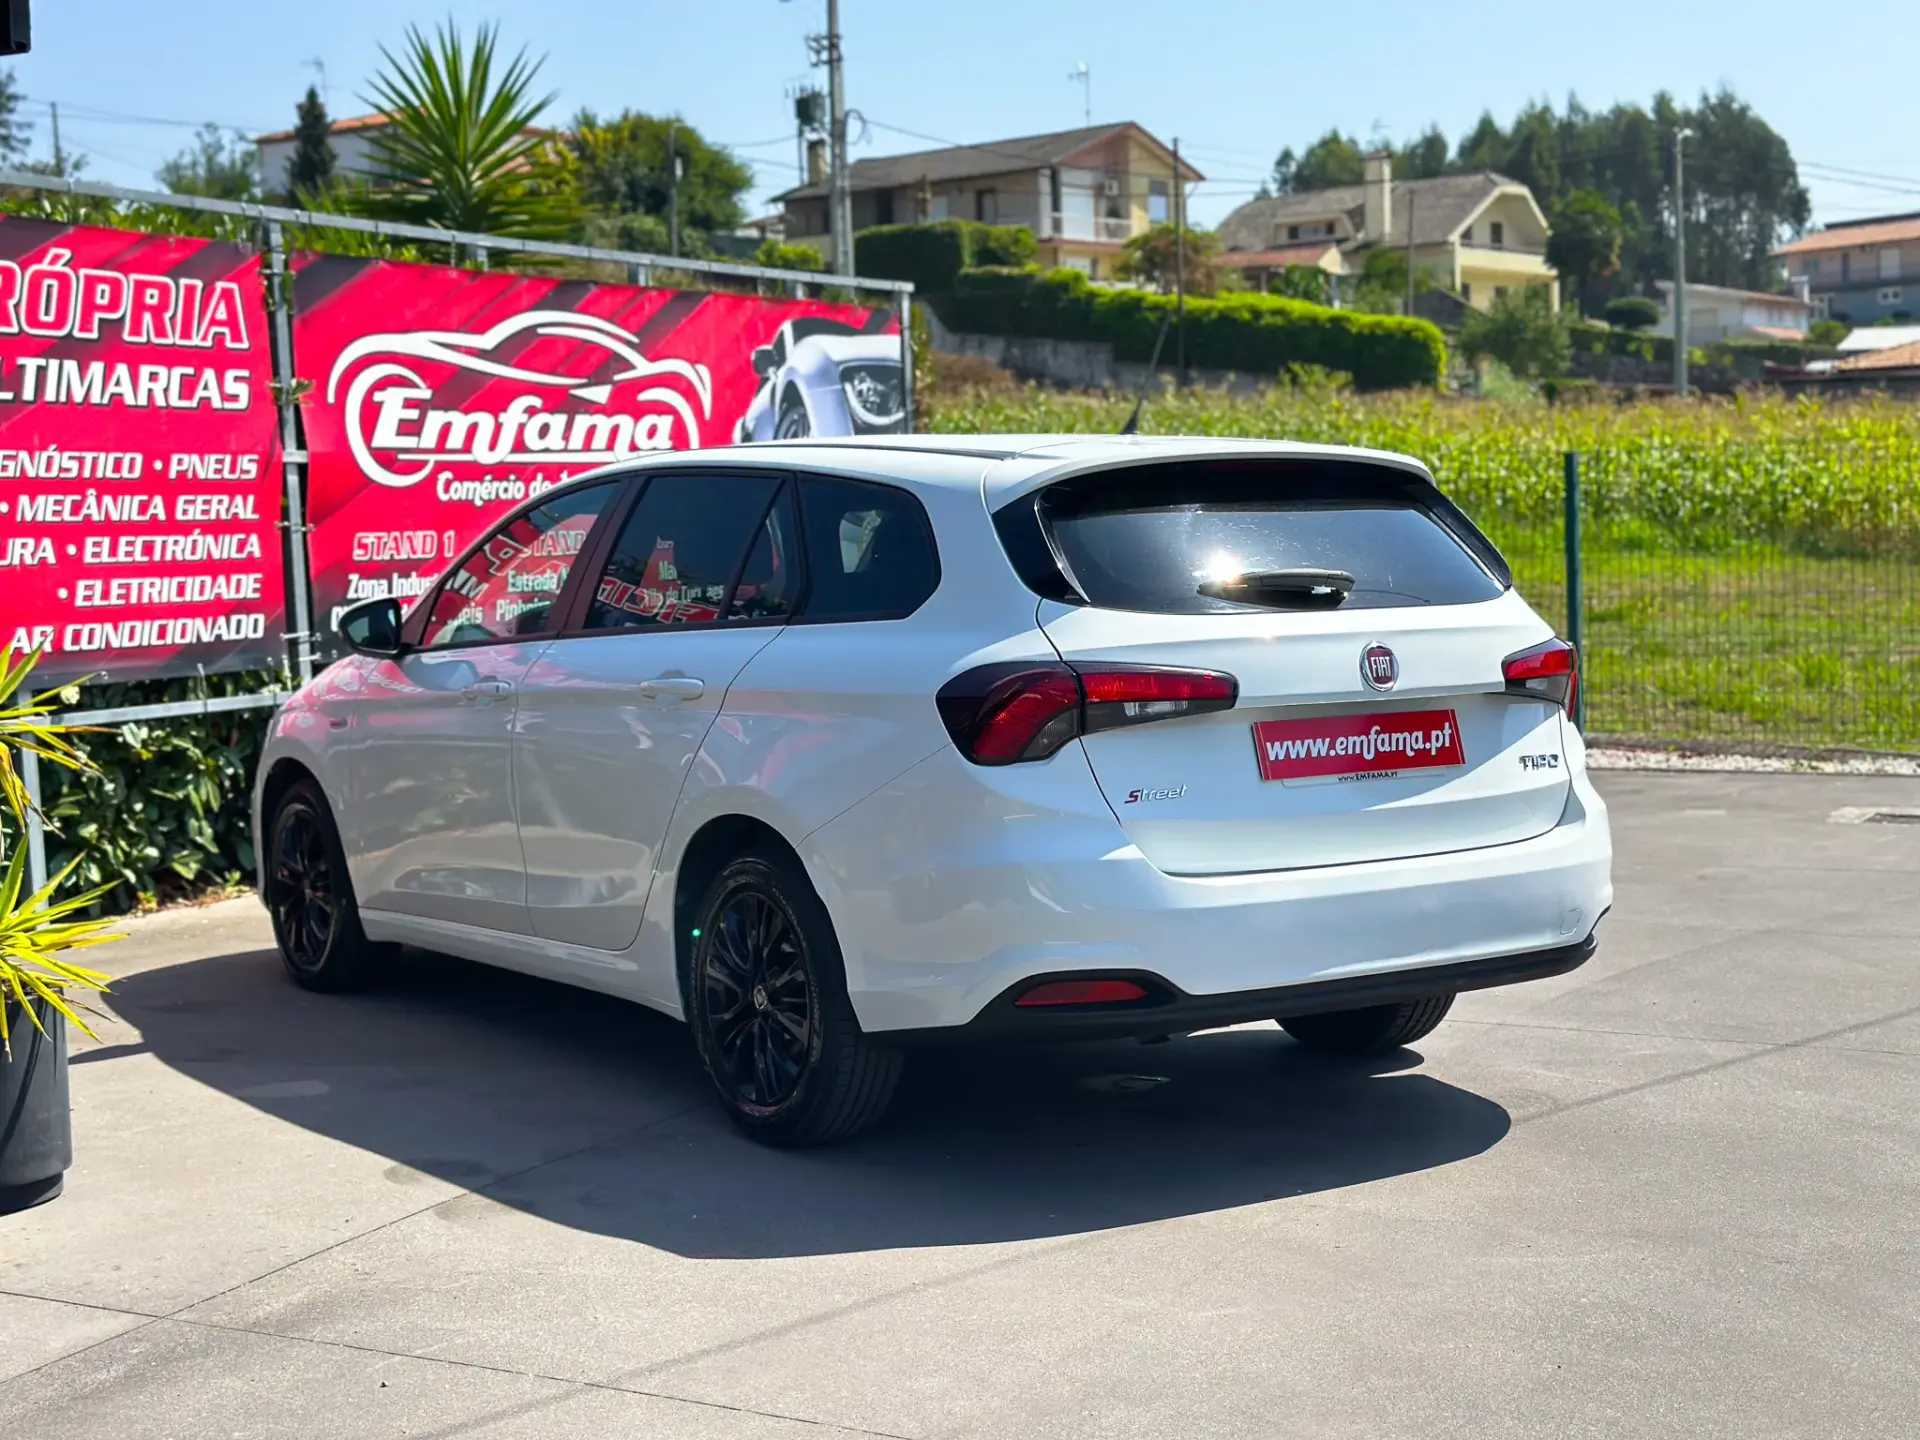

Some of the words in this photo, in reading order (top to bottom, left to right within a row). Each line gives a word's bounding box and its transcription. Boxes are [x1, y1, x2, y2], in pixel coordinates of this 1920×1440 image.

[371, 386, 674, 464] Emfama
[168, 453, 258, 480] PNEUS
[16, 488, 166, 522] MECÂNICA
[175, 494, 260, 521] GERAL
[437, 471, 525, 507] Comércio
[83, 529, 262, 564] ELECTRÓNICA
[352, 531, 438, 561] STAND
[443, 530, 456, 558] 1
[75, 573, 263, 608] ELETRICIDADE
[347, 573, 387, 599] Zona
[10, 626, 54, 654] AR
[63, 613, 265, 652] CONDICIONADO
[1370, 656, 1391, 677] FIAT
[1266, 722, 1452, 761] www.emfama.pt
[1124, 784, 1188, 804] Street
